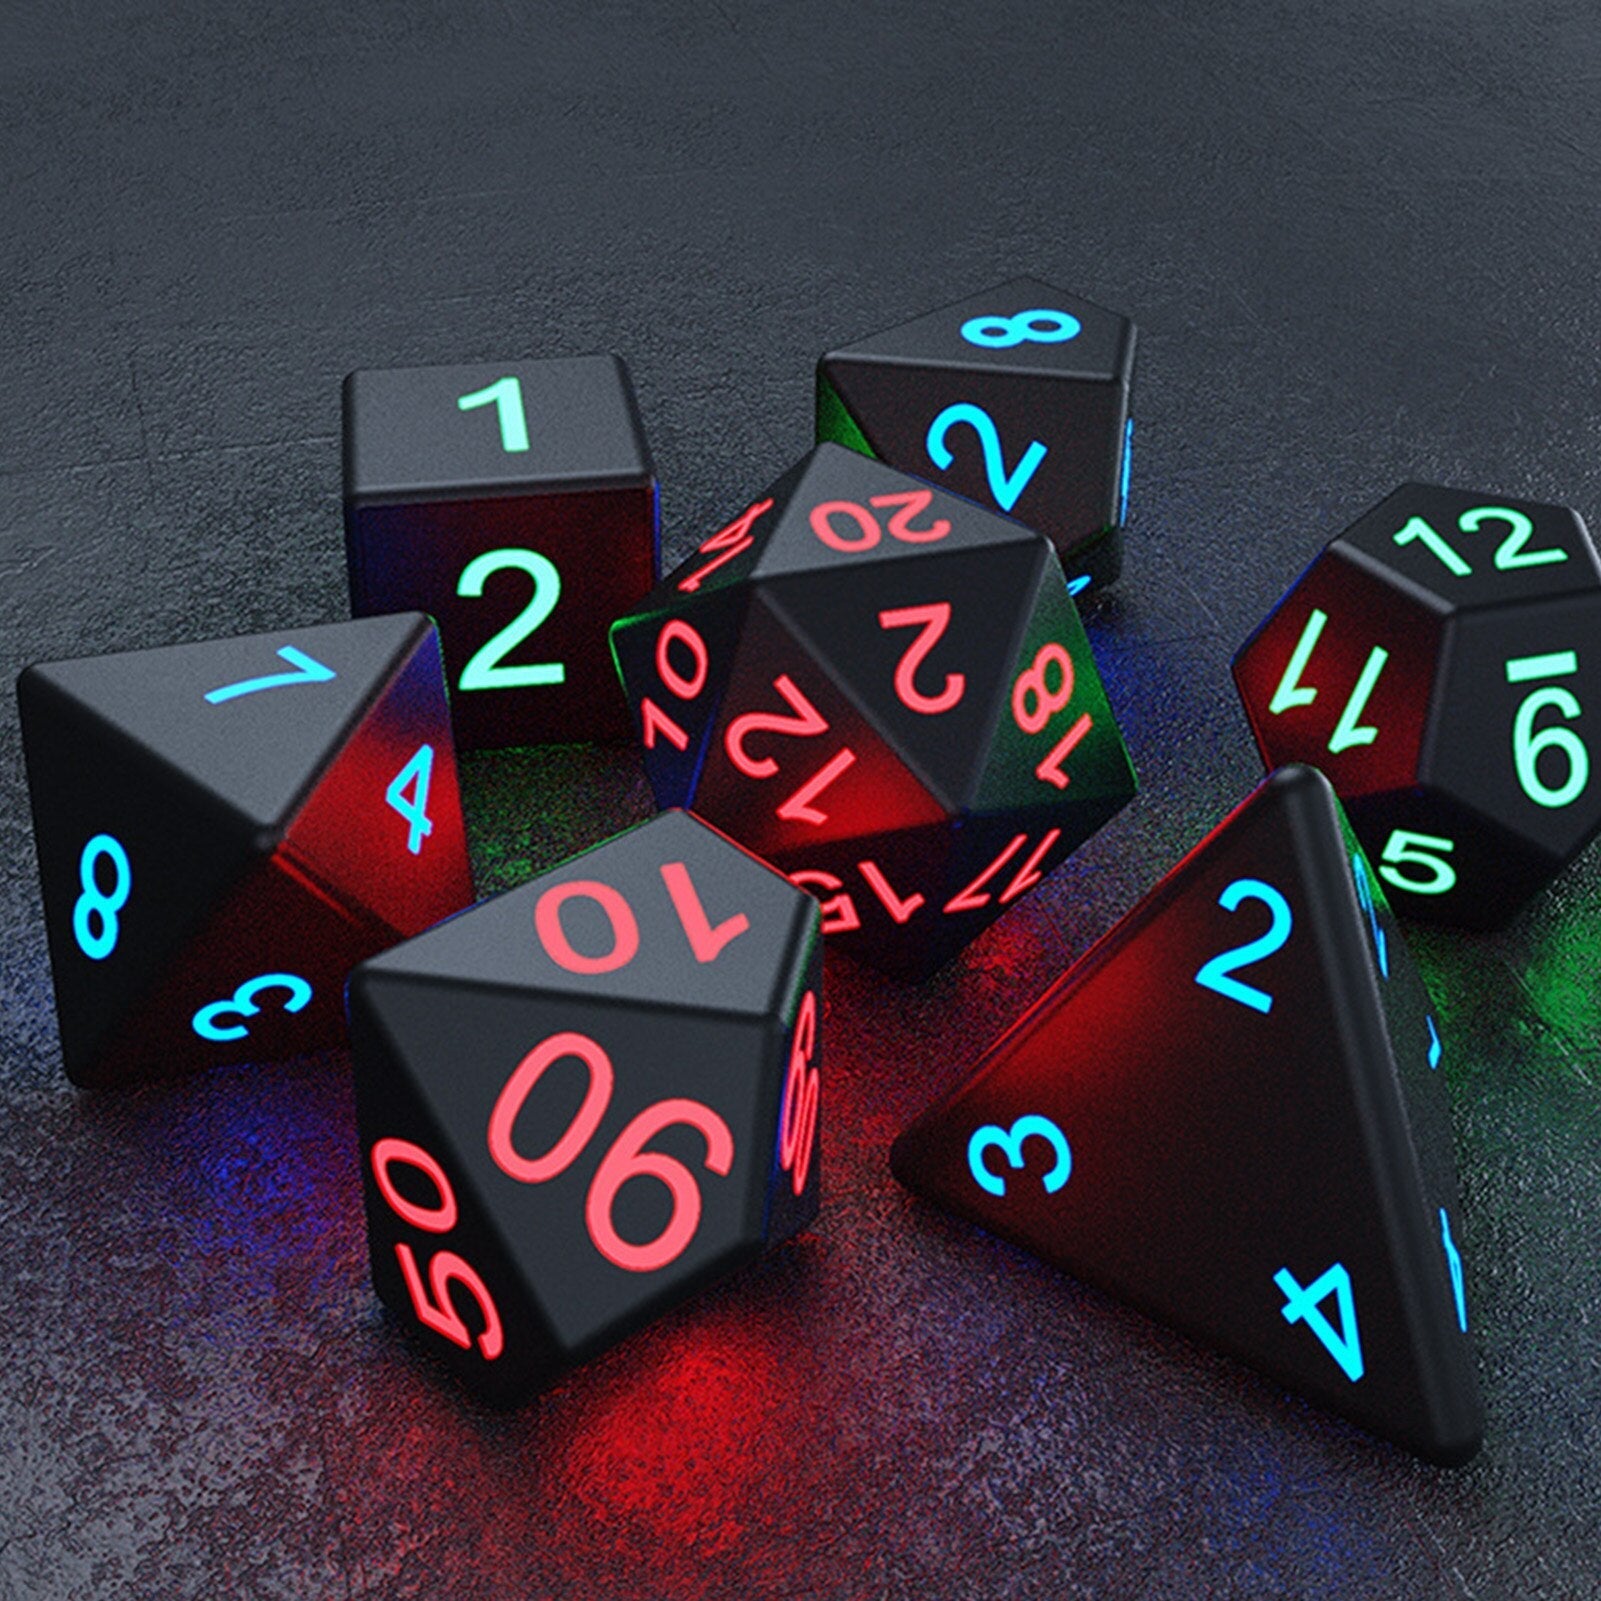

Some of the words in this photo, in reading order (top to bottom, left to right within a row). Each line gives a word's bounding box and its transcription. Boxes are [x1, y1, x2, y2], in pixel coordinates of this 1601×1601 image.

[960, 308, 1082, 349] 8
[457, 376, 530, 452] 1
[926, 402, 1048, 512] 2
[809, 489, 951, 552] 20
[1393, 507, 1568, 576] 12
[457, 548, 565, 691] 2
[879, 602, 965, 714] 2
[641, 619, 708, 751] 10
[1012, 643, 1093, 789] 18
[1269, 609, 1389, 754] 11
[385, 743, 435, 855] 4
[724, 674, 857, 828] 12
[72, 833, 132, 960] 8
[1378, 829, 1456, 894] 5
[534, 862, 750, 975] 10
[1194, 878, 1293, 1014] 2
[191, 972, 313, 1041] 3
[967, 1114, 1072, 1197] 3
[371, 1138, 504, 1360] 50
[1272, 1262, 1365, 1383] 4
